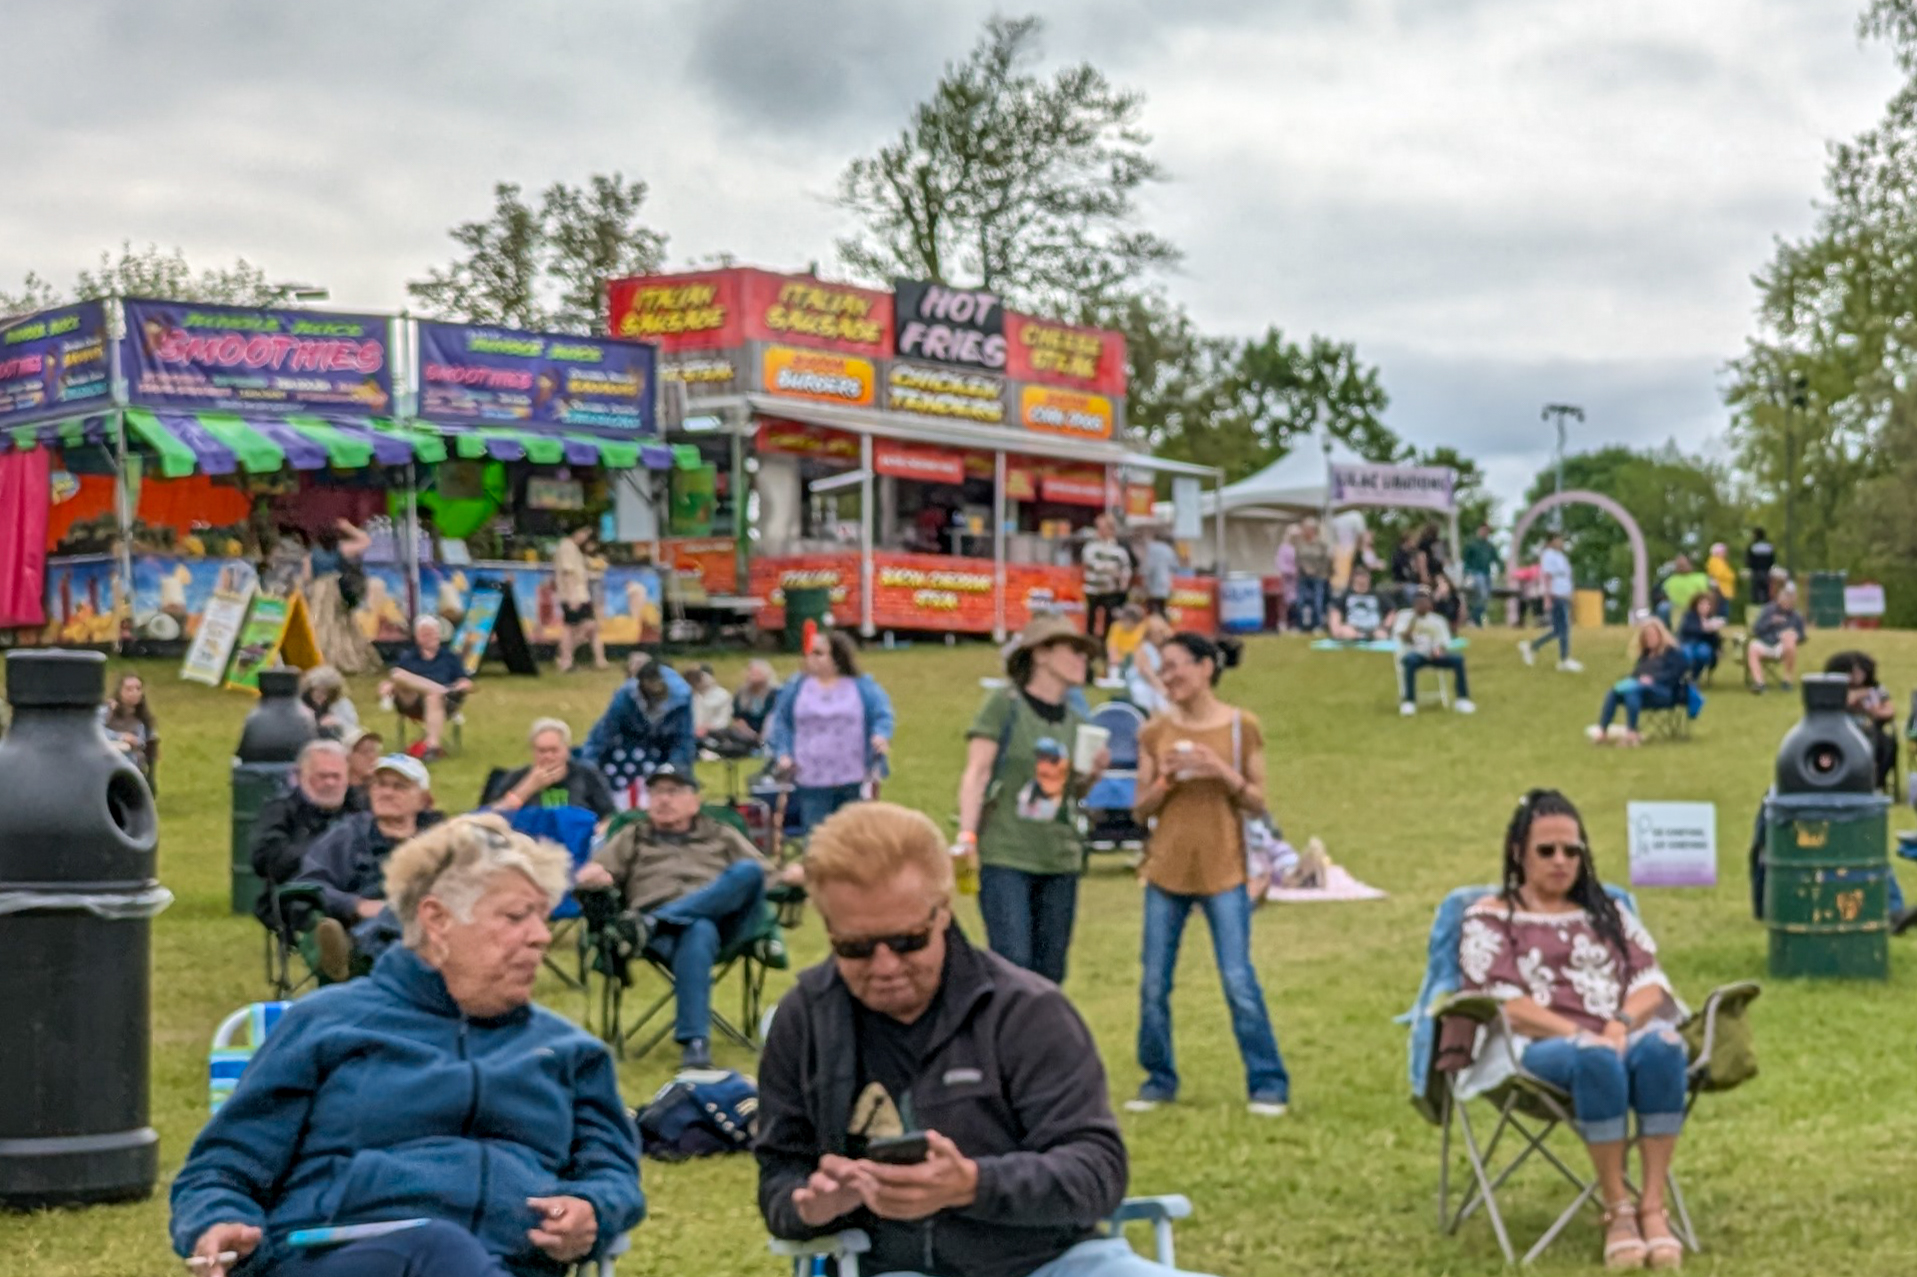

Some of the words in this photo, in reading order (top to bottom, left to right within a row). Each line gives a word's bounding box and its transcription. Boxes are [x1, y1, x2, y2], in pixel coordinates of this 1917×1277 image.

[920, 286, 999, 326] HOT
[158, 328, 383, 373] SMOOTHIES
[900, 321, 1007, 367] FRIES
[777, 369, 862, 398] BURGERS
